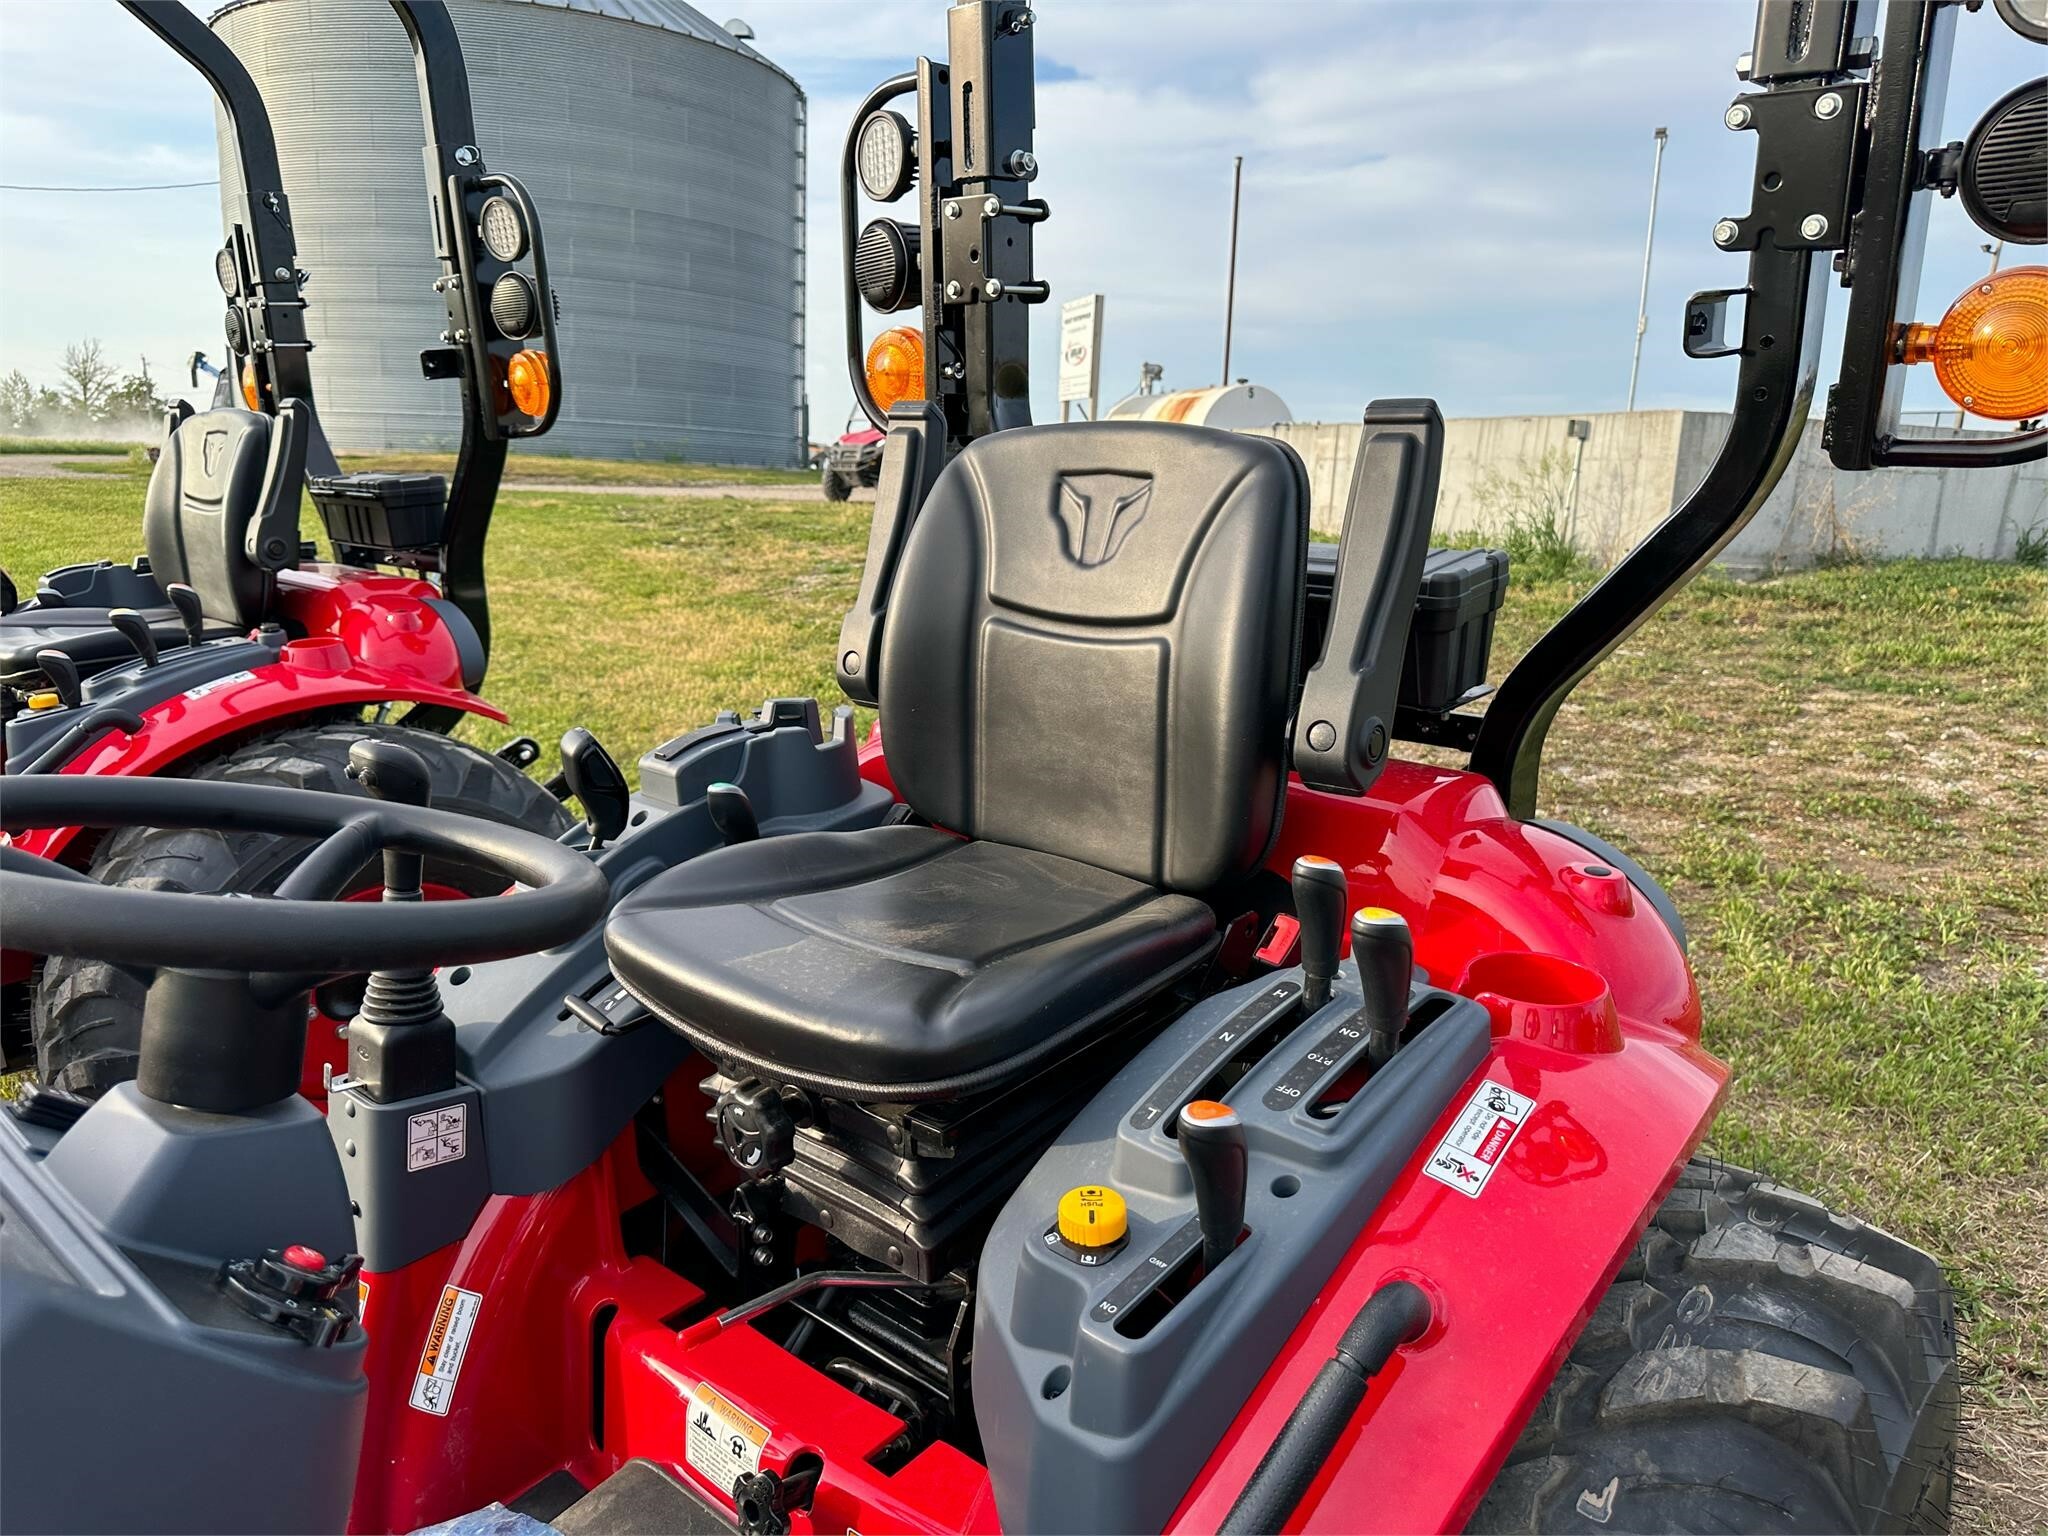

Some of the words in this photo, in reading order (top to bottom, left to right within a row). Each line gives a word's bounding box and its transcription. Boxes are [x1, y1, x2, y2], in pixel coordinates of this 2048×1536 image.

[1272, 988, 1289, 998] H
[1218, 1031, 1235, 1043] N
[1338, 1026, 1360, 1039] ON
[1306, 1052, 1334, 1067] P.T.O
[1274, 1084, 1301, 1098] OFF
[1146, 1106, 1162, 1120] L
[1456, 1125, 1472, 1147] operator
[1479, 1129, 1506, 1162] DANGER
[1148, 1256, 1168, 1269] 4WD
[1099, 1301, 1118, 1314] ON
[429, 1297, 454, 1352] WARNING
[443, 1343, 452, 1358] clear
[451, 1316, 461, 1335] raised
[457, 1298, 466, 1315] boom
[447, 1361, 455, 1375] and
[720, 1403, 754, 1436] WARNING
